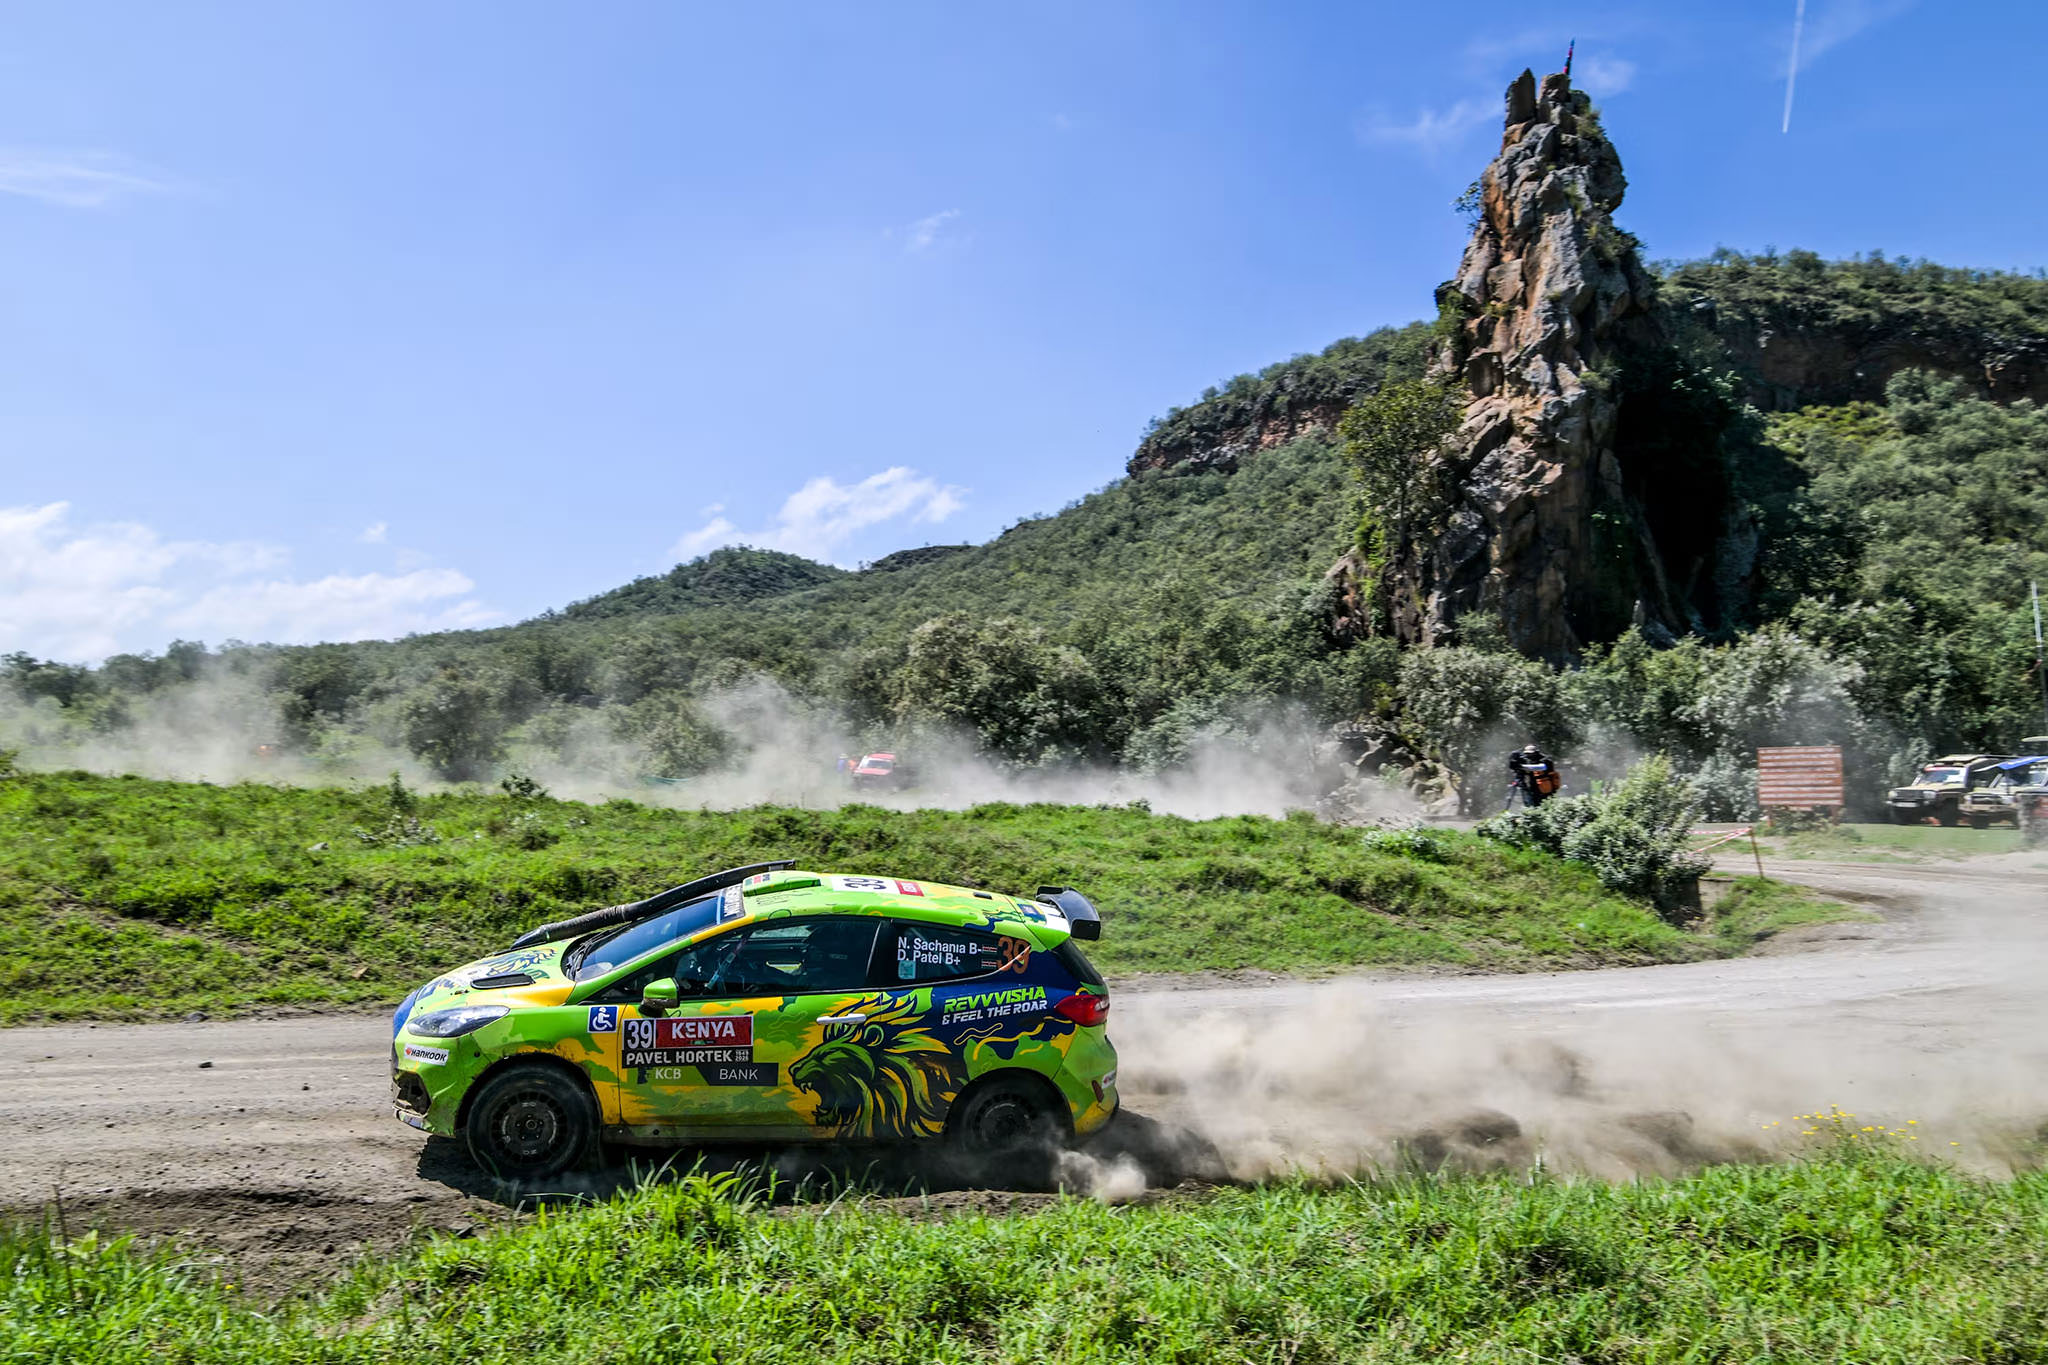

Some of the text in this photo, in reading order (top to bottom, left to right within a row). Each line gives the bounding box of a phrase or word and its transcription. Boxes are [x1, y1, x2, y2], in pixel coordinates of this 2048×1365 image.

[842, 877, 888, 890] 39
[898, 936, 910, 949] N.
[913, 938, 966, 954] Sachania
[897, 949, 961, 966] D. Patel B+
[998, 936, 1031, 974] 39
[944, 986, 1046, 1014] REVVVISHA
[942, 1000, 1048, 1025] & FEEL THE ROAR
[627, 1020, 653, 1049] 39
[672, 1020, 736, 1039] KENYA
[626, 1050, 733, 1065] PAVEL HORTEK
[655, 1068, 682, 1080] KCB
[719, 1068, 758, 1080] BANK
